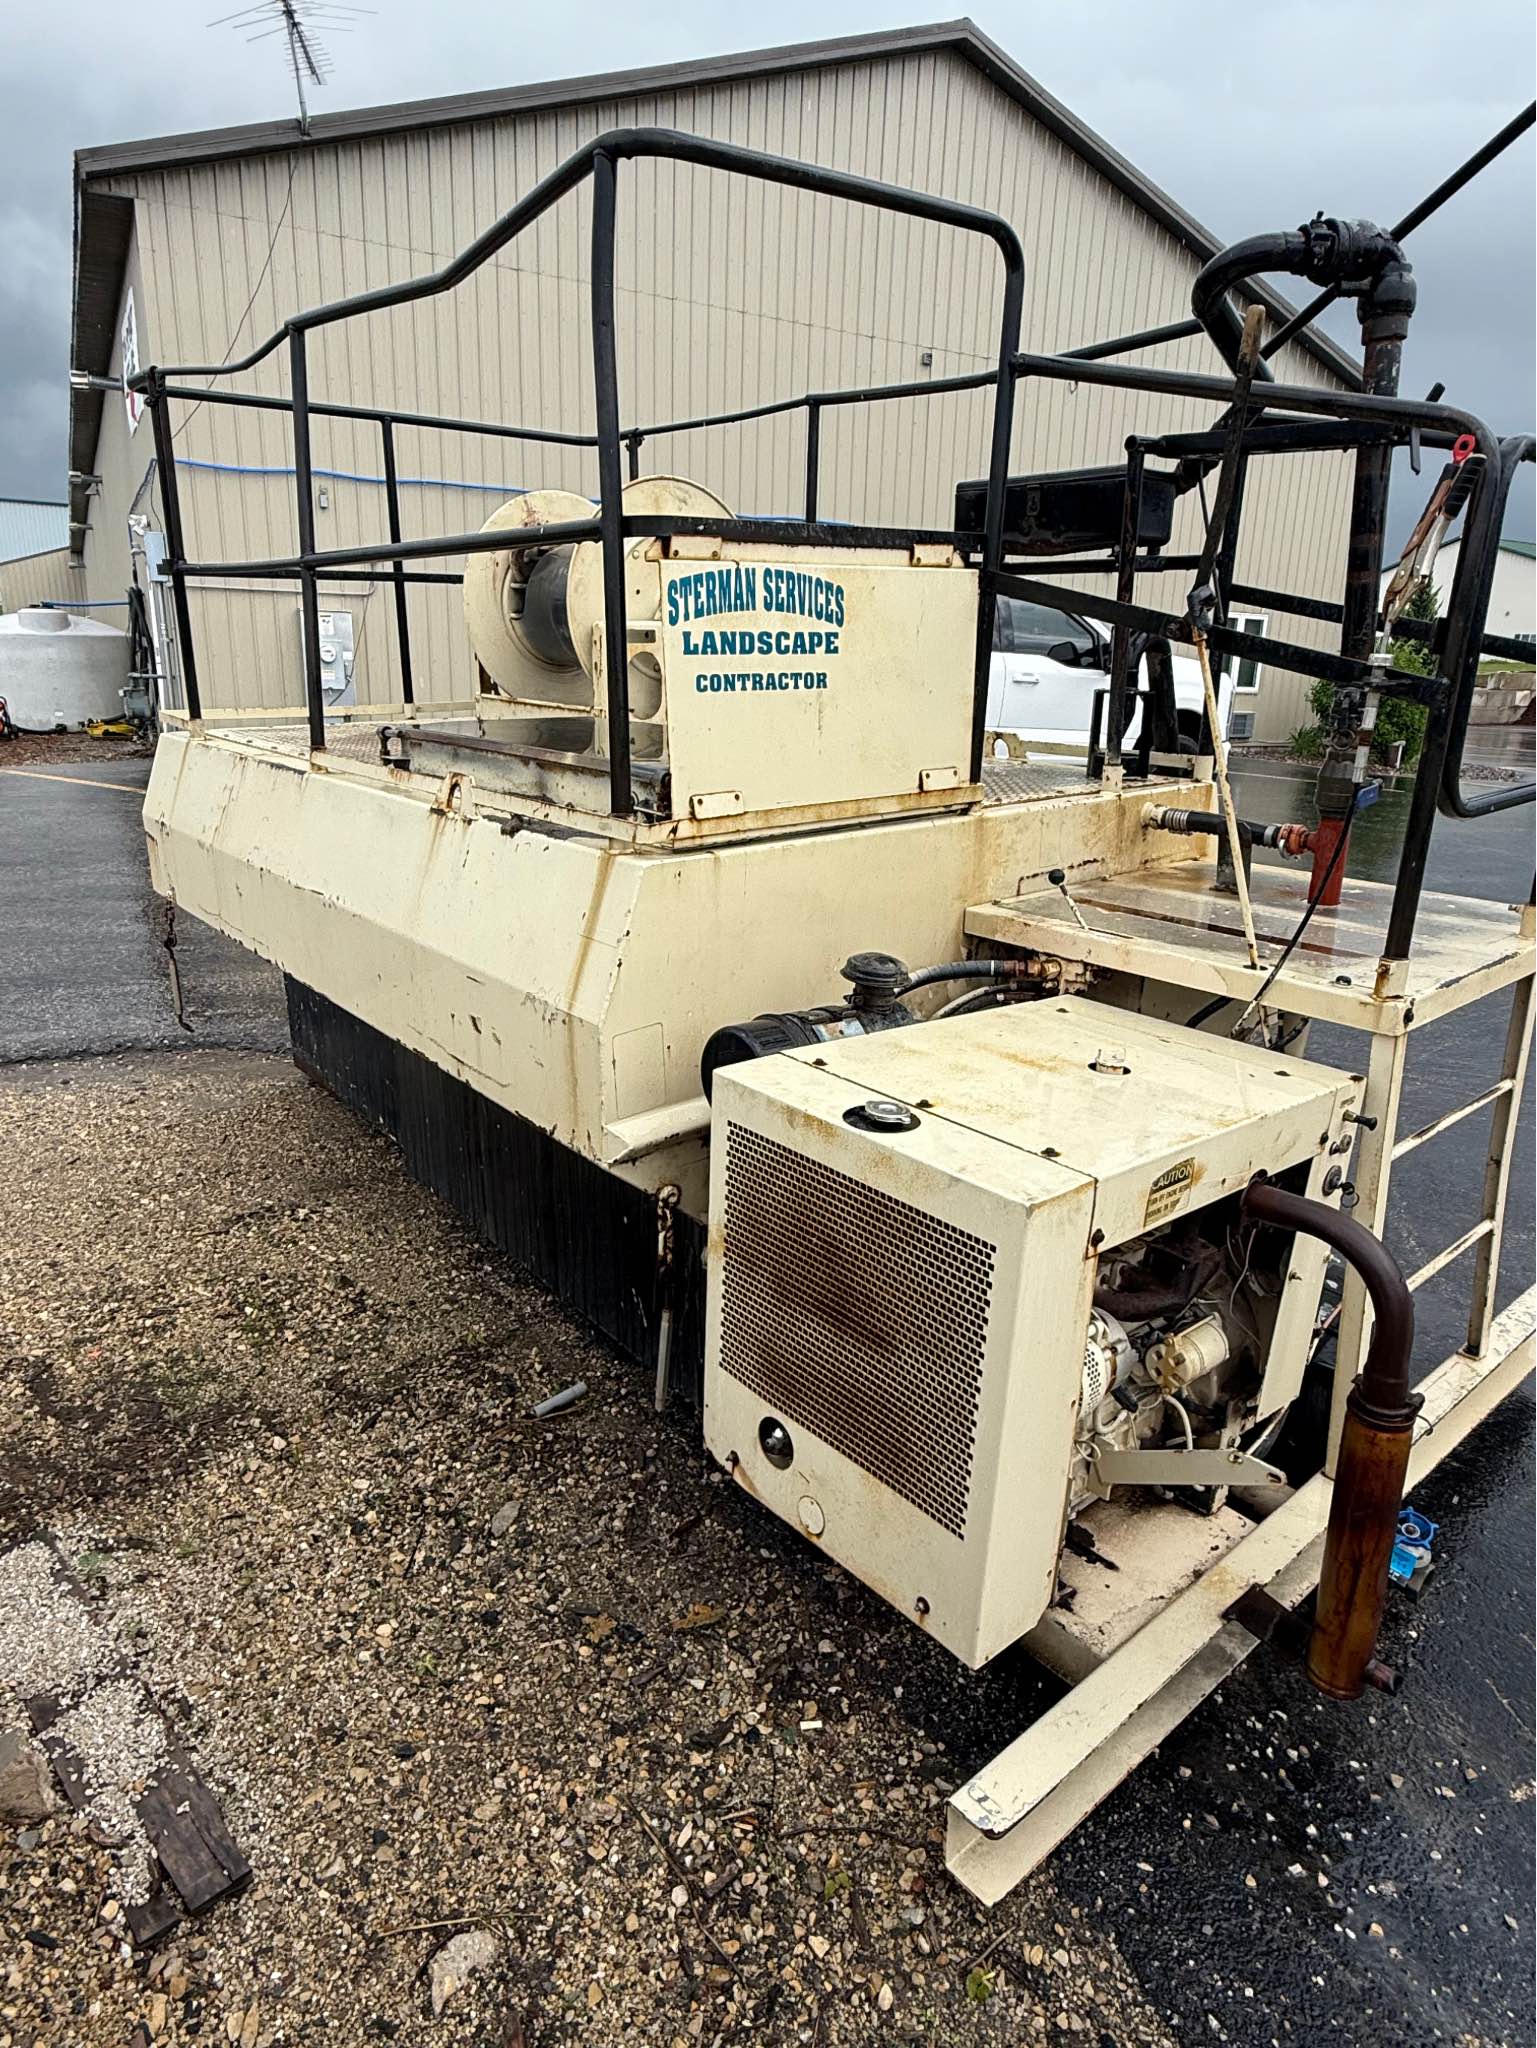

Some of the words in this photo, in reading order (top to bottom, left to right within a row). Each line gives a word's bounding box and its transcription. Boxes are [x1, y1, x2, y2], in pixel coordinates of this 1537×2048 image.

[667, 567, 757, 626] STERMAN
[763, 567, 845, 628] SERVICES
[682, 631, 839, 655] LANDSCAPE
[696, 672, 828, 692] CONTRACTOR
